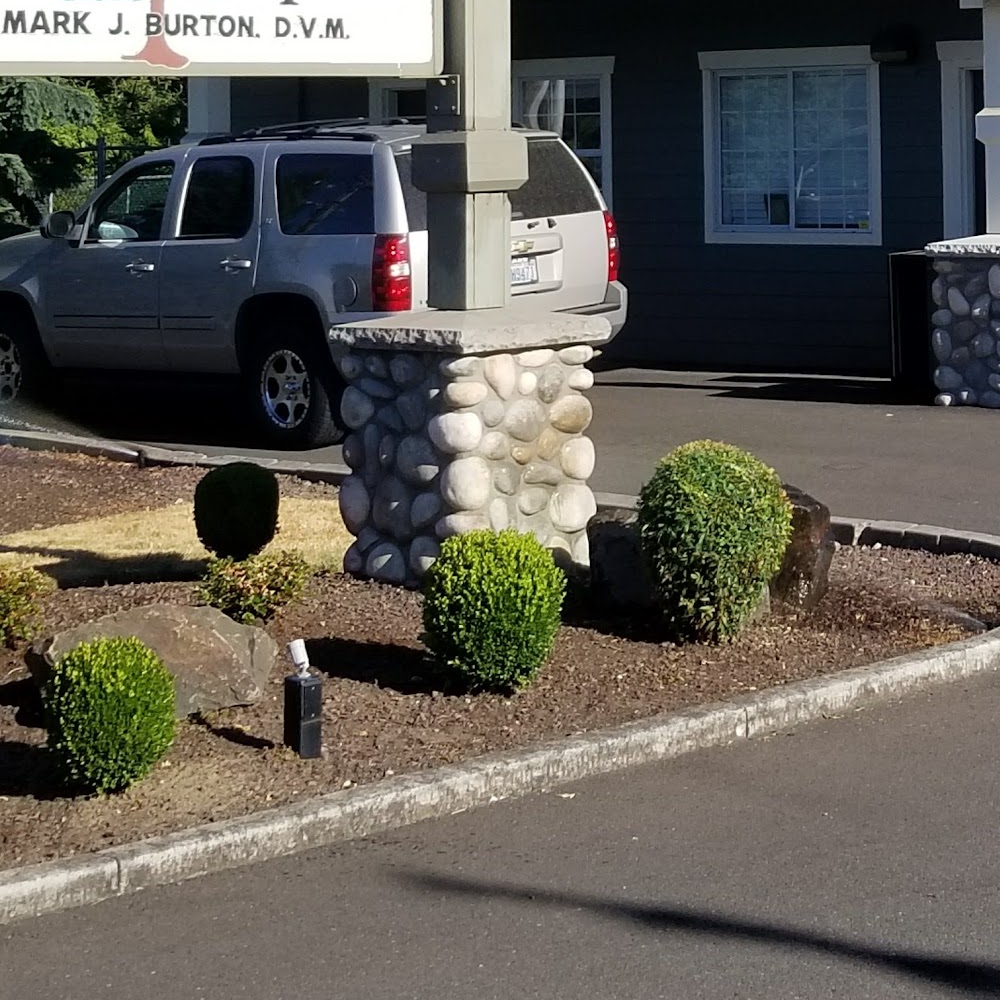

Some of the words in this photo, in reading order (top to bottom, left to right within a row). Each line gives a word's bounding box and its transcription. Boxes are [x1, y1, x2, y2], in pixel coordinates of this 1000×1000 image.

[1, 9, 92, 35] MARK
[108, 12, 130, 35] J.
[275, 15, 350, 39] D.V.M.
